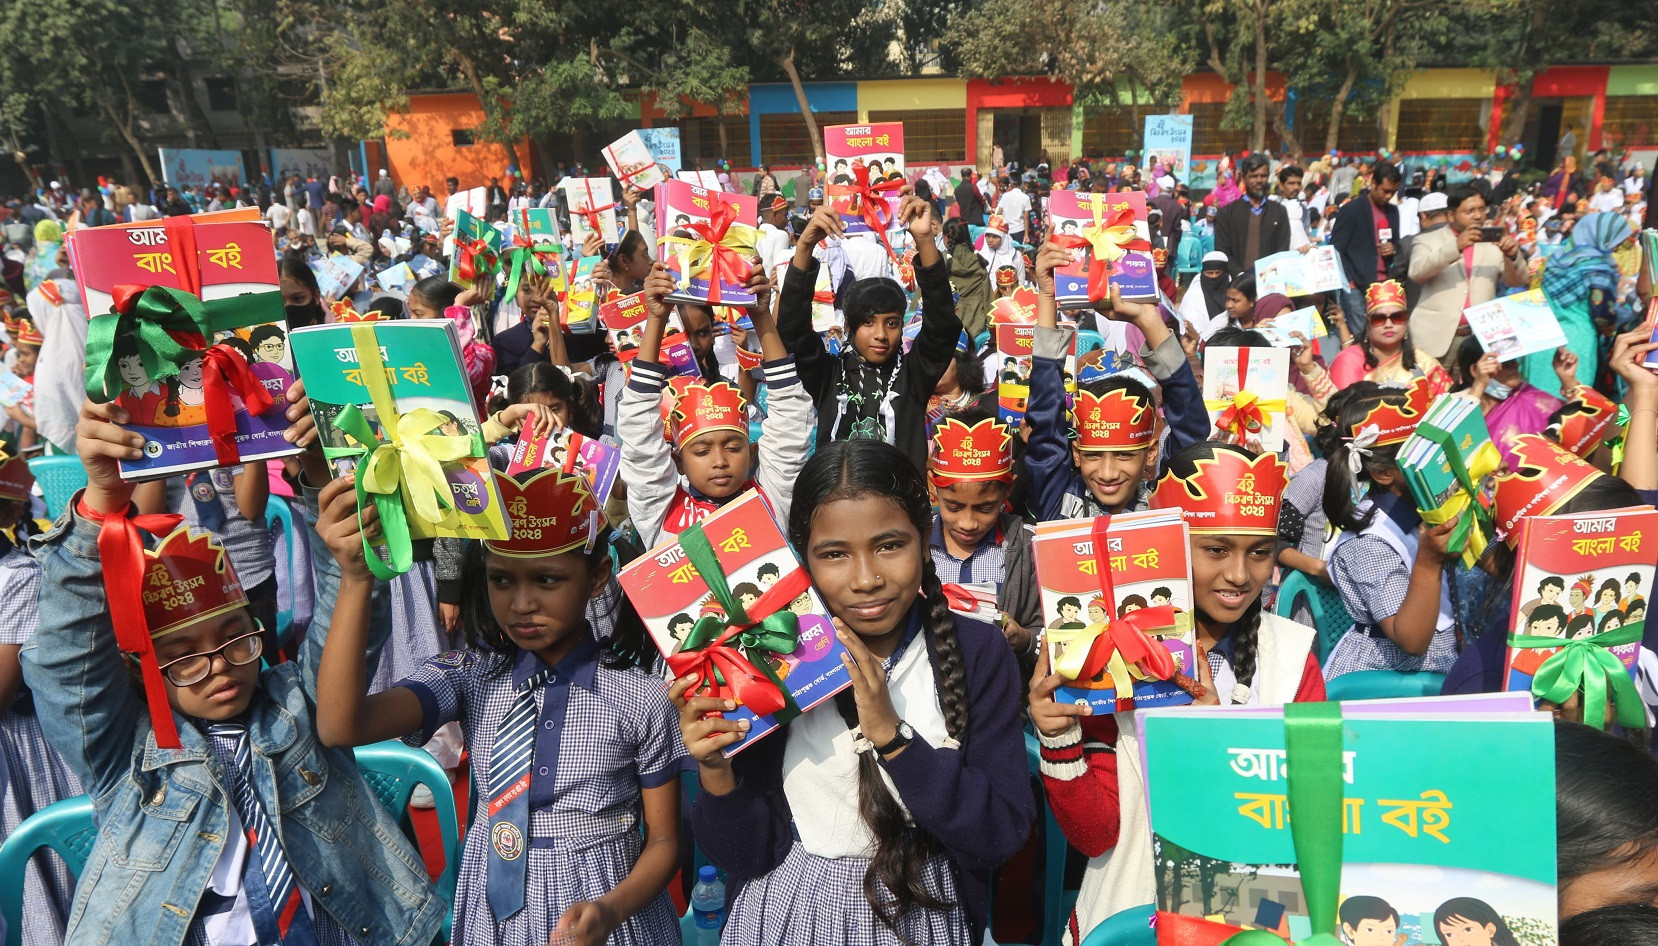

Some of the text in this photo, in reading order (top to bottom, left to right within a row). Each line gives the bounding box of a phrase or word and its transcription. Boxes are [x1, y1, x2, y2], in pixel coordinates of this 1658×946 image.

[845, 127, 871, 136] আমার
[846, 133, 890, 148] বাংলা বই
[127, 228, 167, 246] আম
[134, 243, 242, 275] বাং বই
[621, 304, 645, 318] বাংলা
[1014, 327, 1034, 336] আমা
[400, 362, 431, 387] বই
[1089, 407, 1102, 422] বই
[960, 436, 974, 451] বই
[523, 443, 538, 467] বাংলা
[962, 458, 982, 466] ২০২৪
[451, 481, 479, 499] চতুর্থ
[1236, 473, 1255, 494] বই
[508, 496, 528, 518] বই
[1224, 492, 1253, 505] বিতরণ
[1240, 505, 1265, 517] ২০২৪
[529, 516, 557, 528] উৎসব
[1573, 517, 1617, 534] আমার
[513, 529, 542, 540] ২০২৪
[719, 527, 752, 553] বই
[1572, 530, 1642, 557] বাংলা বই
[654, 543, 687, 568] আম
[1077, 548, 1159, 575] বালা বই
[146, 564, 171, 587] বই
[173, 575, 206, 594] উৎসব
[162, 592, 195, 611] ২০২৪
[1378, 789, 1453, 844] বই
